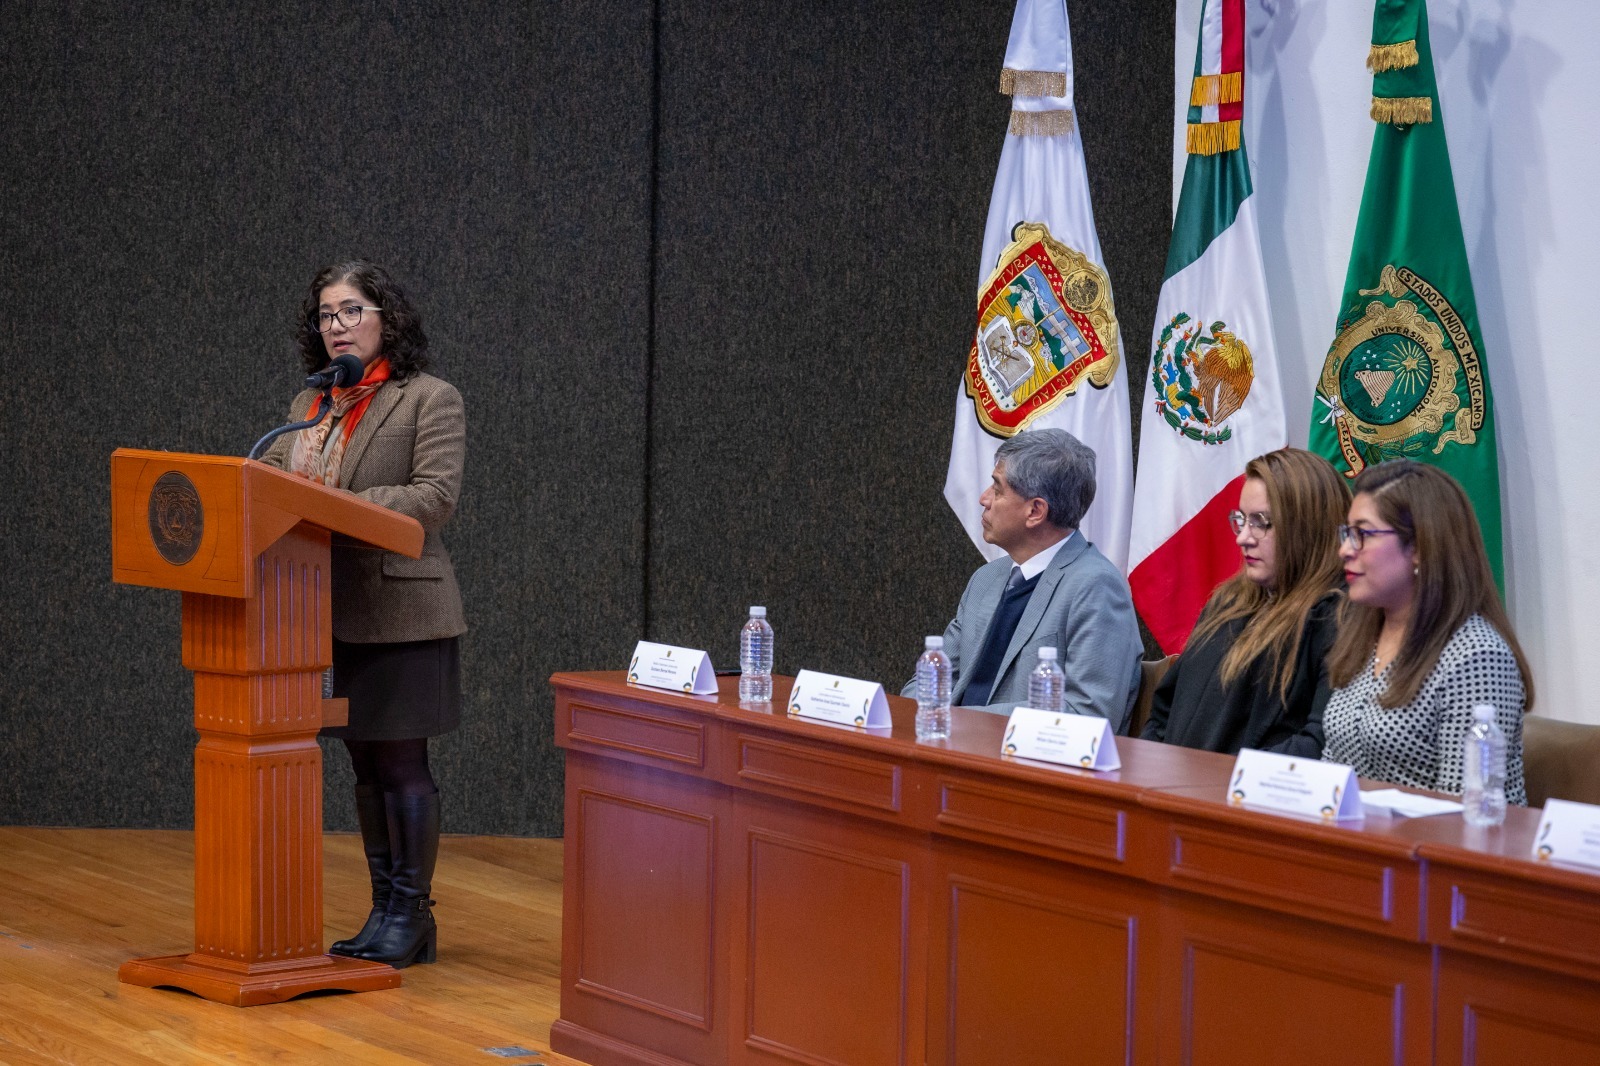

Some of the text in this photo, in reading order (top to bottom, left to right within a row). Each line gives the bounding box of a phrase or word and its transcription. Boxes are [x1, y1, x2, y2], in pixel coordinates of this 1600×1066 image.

[1371, 325, 1440, 418] UNIVERSIDAD AUTONOMA
[1399, 269, 1484, 427] ESTADOS UNIDOS MEXICANOS
[1339, 421, 1357, 463] MEXICO
